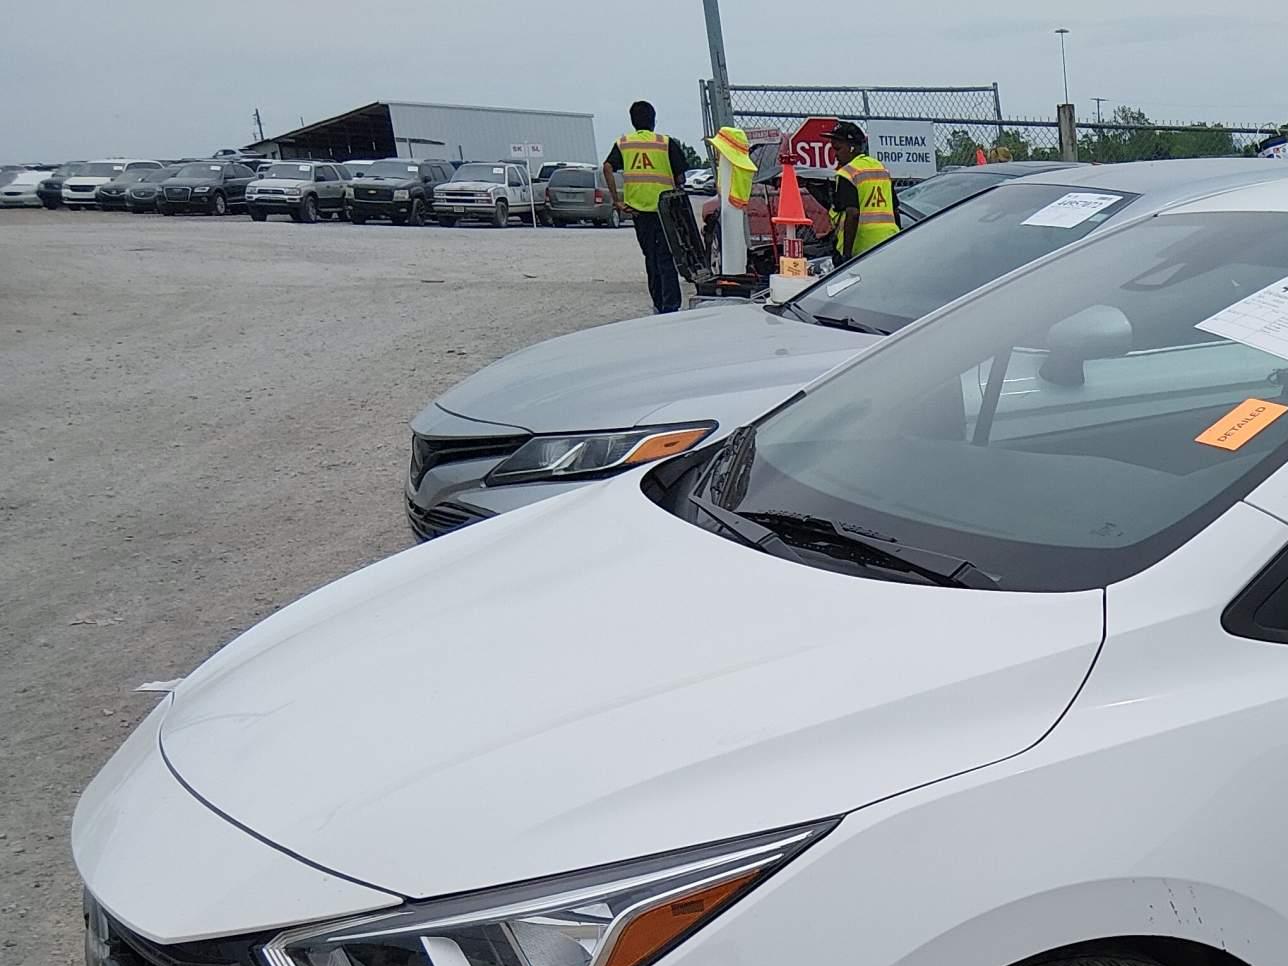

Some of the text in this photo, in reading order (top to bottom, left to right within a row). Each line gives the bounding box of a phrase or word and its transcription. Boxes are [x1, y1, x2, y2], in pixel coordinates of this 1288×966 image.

[879, 135, 926, 147] TITLEMAX
[796, 142, 839, 169] STO
[877, 151, 931, 163] DROP ZONE
[1217, 406, 1267, 442] DETAILED
